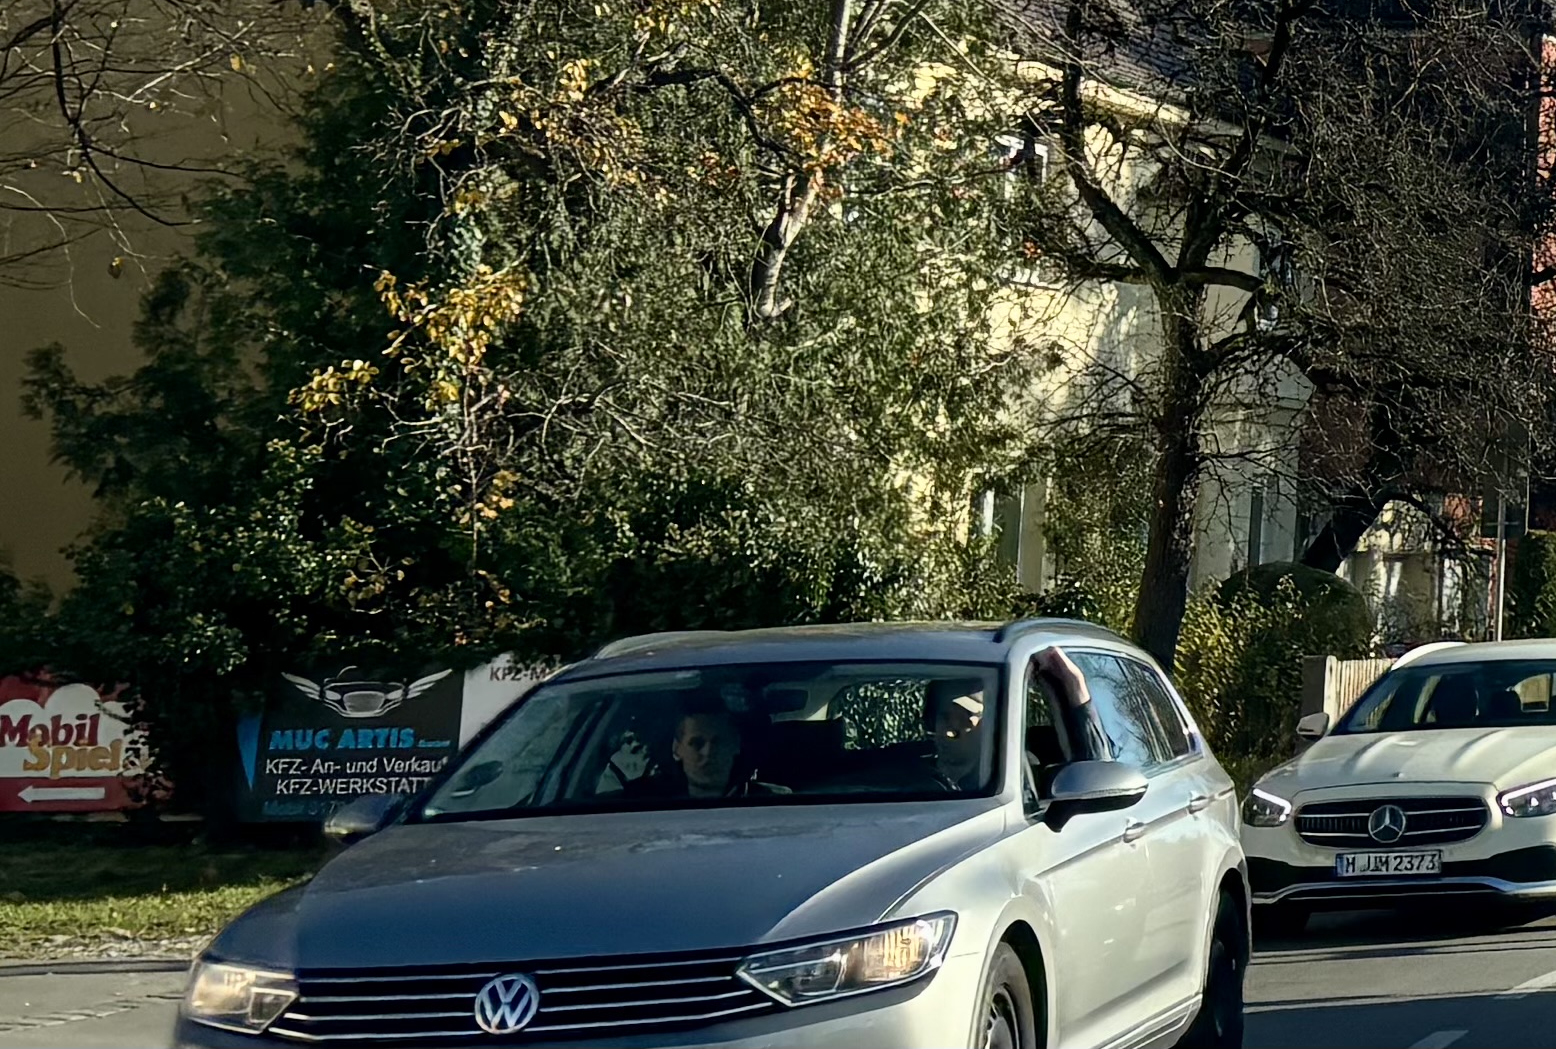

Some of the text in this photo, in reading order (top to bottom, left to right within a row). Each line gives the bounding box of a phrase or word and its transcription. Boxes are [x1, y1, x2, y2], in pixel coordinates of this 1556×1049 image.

[0, 713, 100, 747] Mobil
[269, 729, 331, 749] MUC
[337, 728, 415, 748] ARTIS
[23, 738, 122, 779] Spiel
[265, 758, 307, 774] KFZ-
[311, 758, 341, 774] An-
[346, 757, 378, 773] und
[276, 777, 433, 794] KFZ-WERKSTATT
[1393, 854, 1437, 871] 2373
